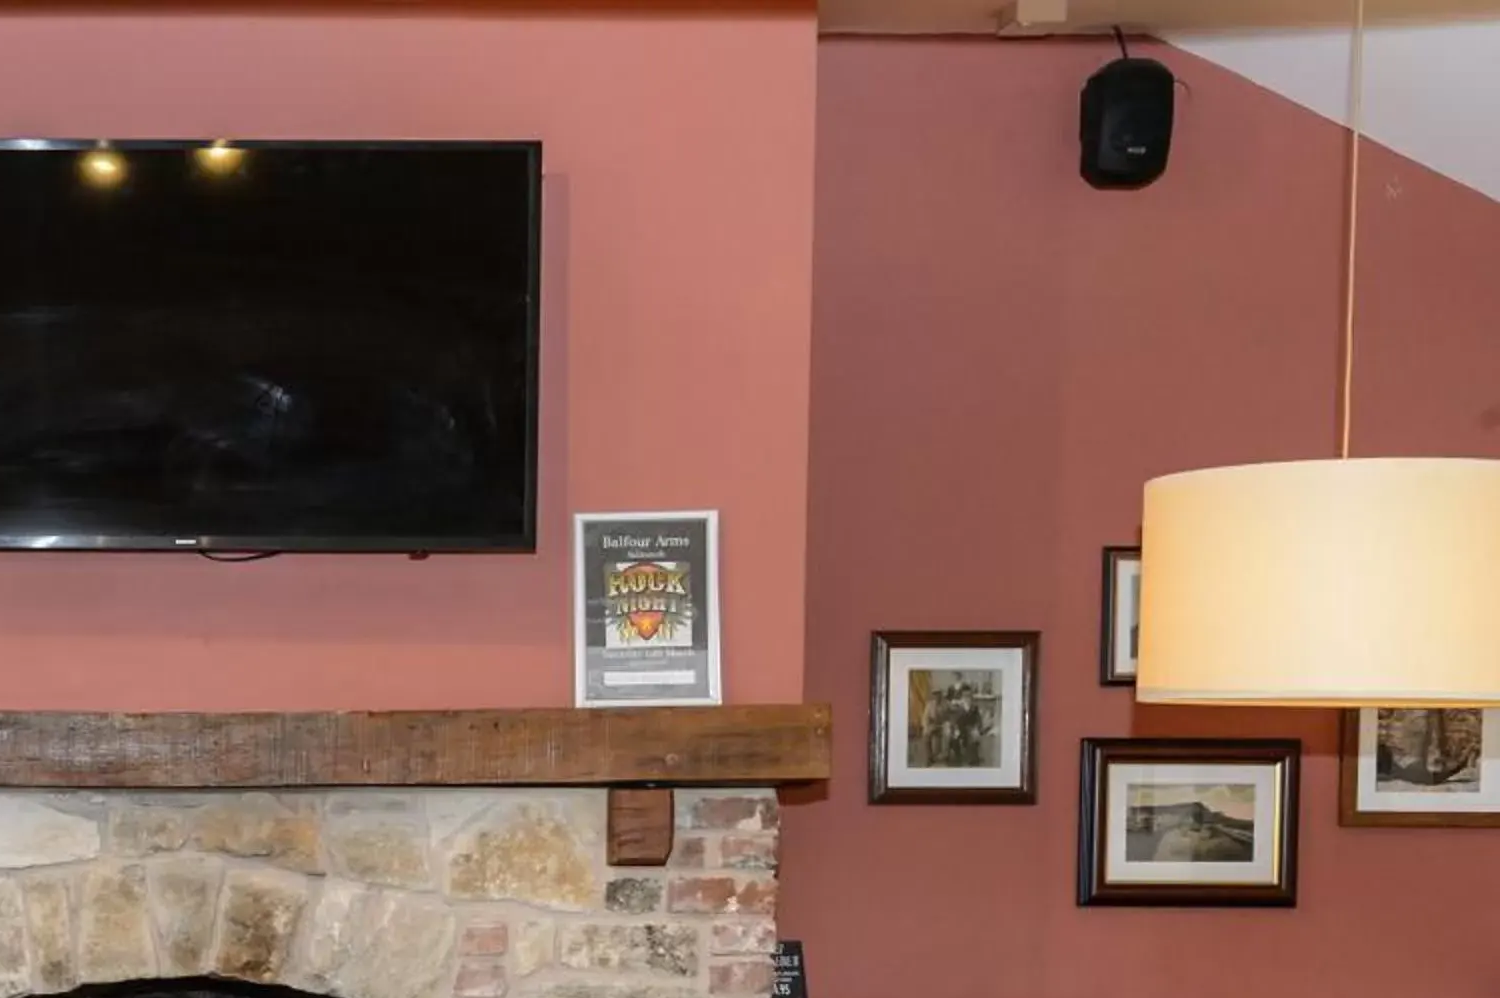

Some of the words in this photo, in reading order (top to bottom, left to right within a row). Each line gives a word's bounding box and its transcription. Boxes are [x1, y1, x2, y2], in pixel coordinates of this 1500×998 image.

[602, 534, 650, 549] Balfour
[654, 535, 691, 548] Arms
[609, 571, 687, 597] ROCK
